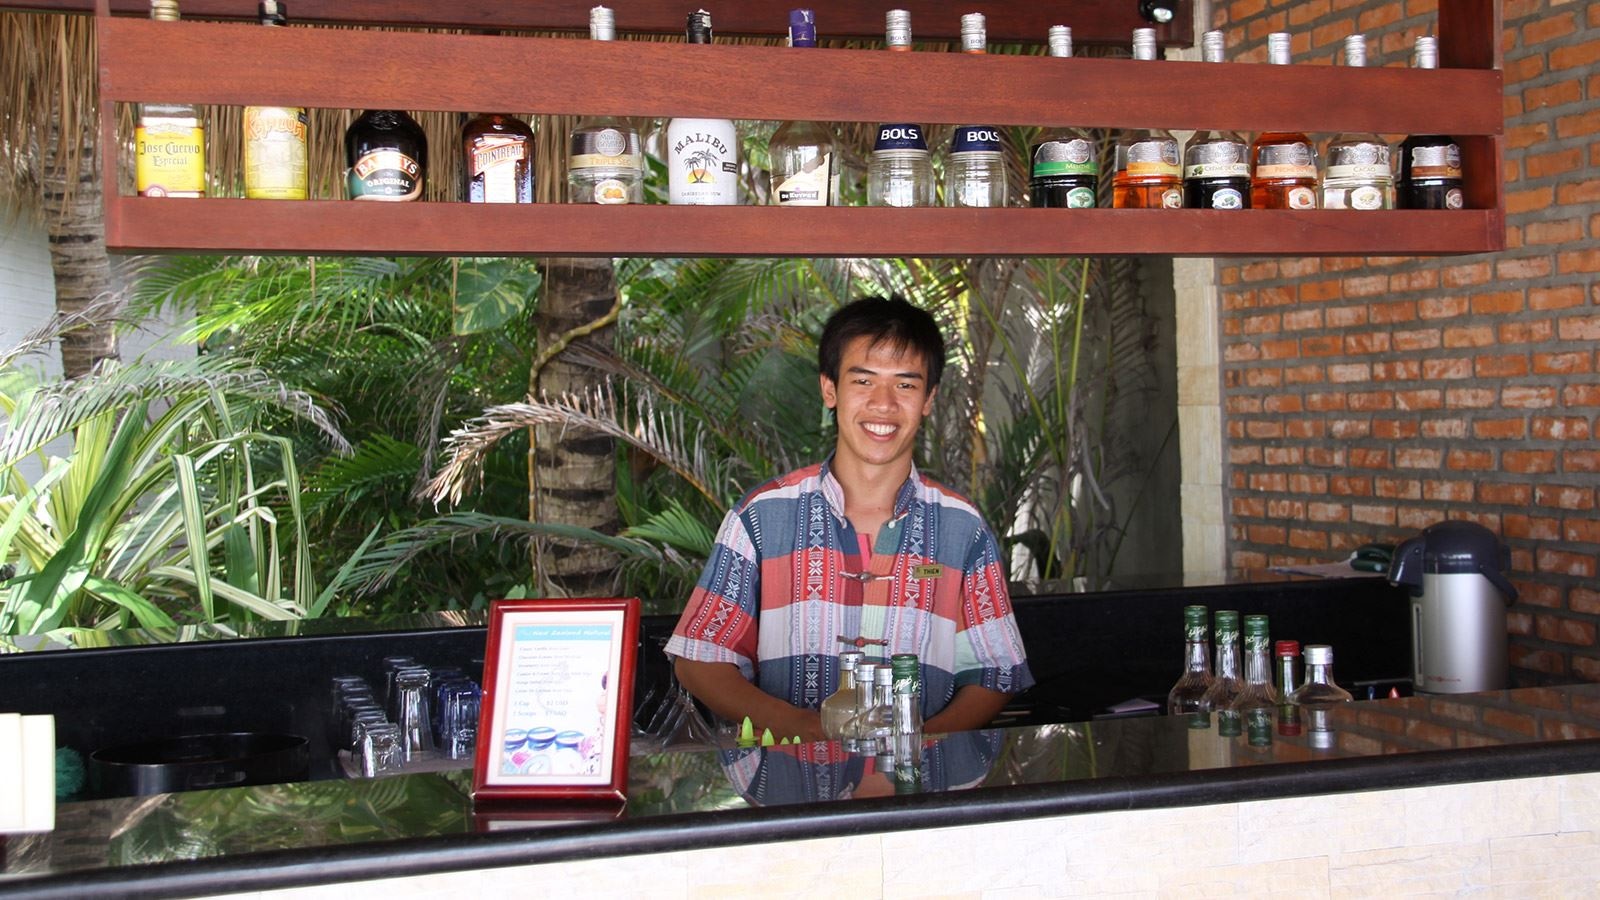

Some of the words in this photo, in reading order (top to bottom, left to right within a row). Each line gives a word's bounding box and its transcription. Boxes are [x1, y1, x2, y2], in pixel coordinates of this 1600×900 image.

[881, 129, 918, 140] BOLS
[967, 131, 1000, 142] BOLS
[674, 133, 728, 155] MALIBU
[358, 152, 417, 175] BAYS
[477, 144, 522, 170] COINTREAU
[367, 178, 410, 188] ORIGINAL
